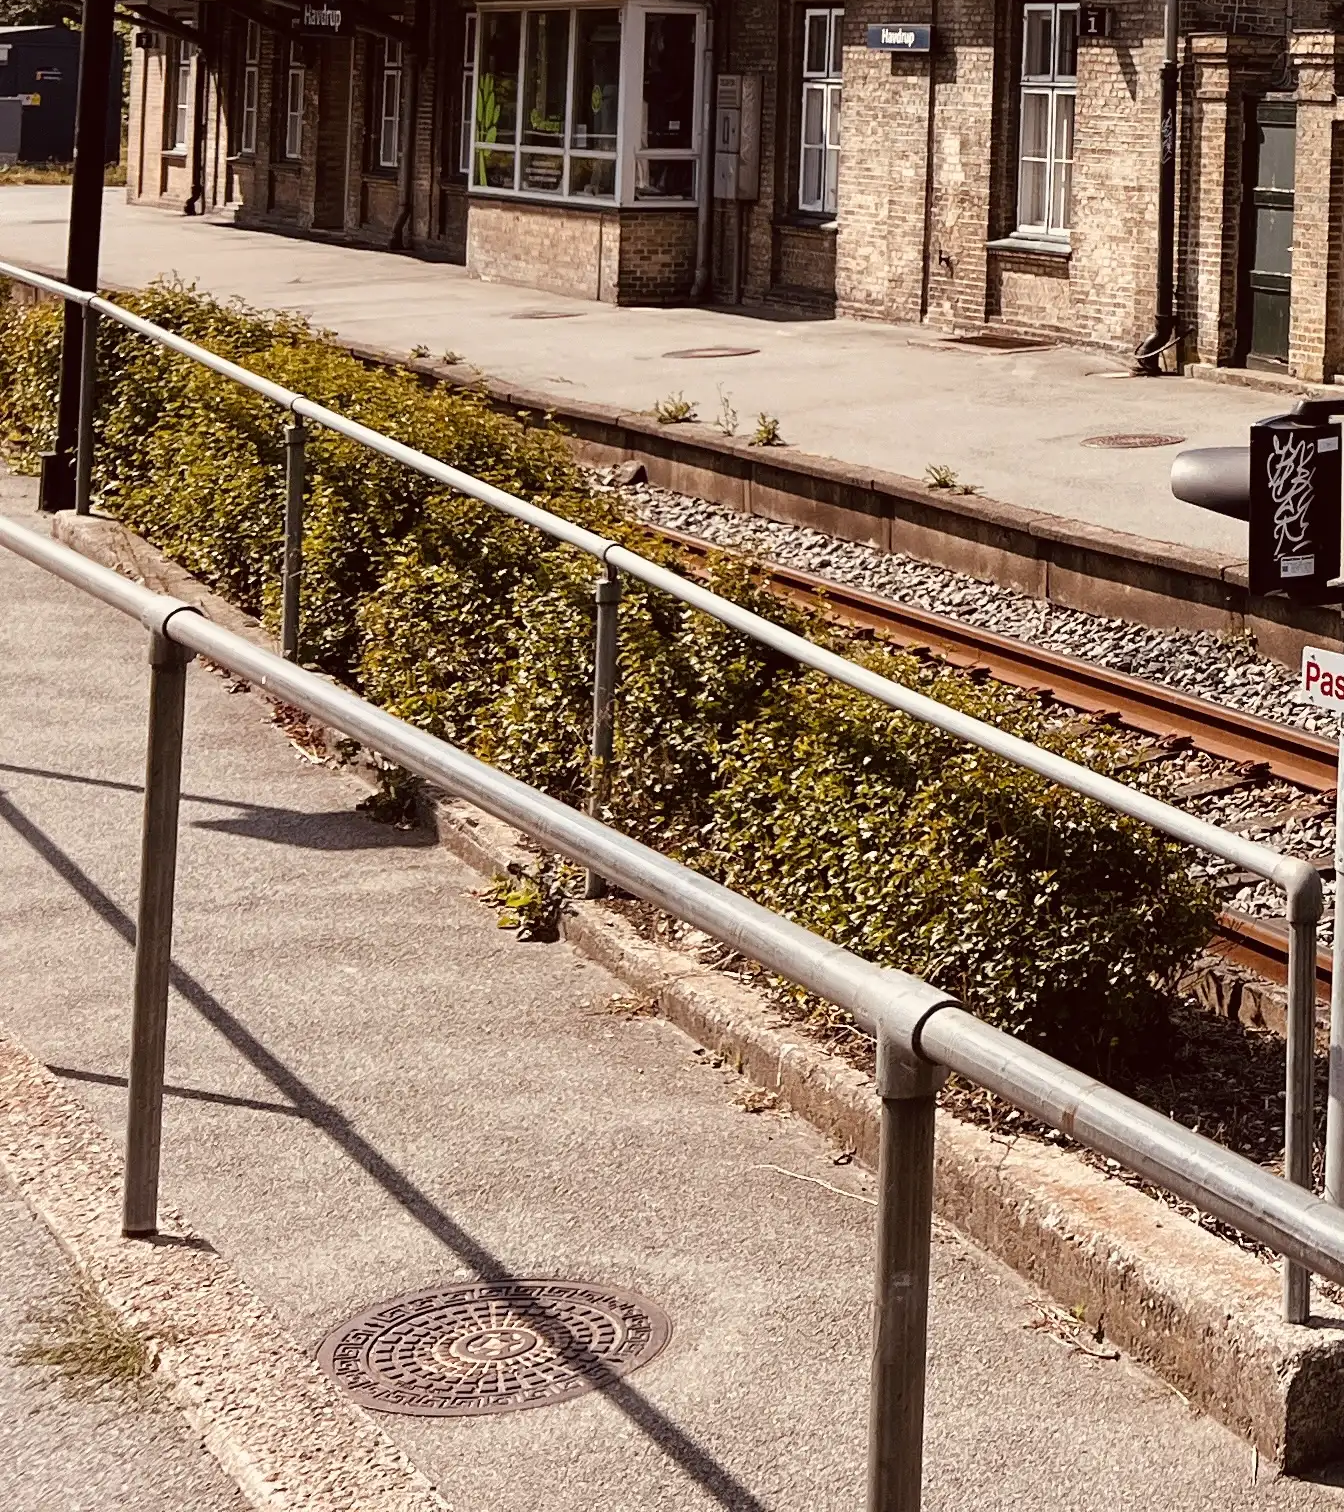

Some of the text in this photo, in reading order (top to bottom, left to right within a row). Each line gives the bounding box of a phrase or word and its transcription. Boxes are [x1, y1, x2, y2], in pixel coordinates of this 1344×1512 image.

[304, 3, 342, 32] Havdrup
[1088, 17, 1097, 33] 1
[881, 28, 915, 47] Havdrup
